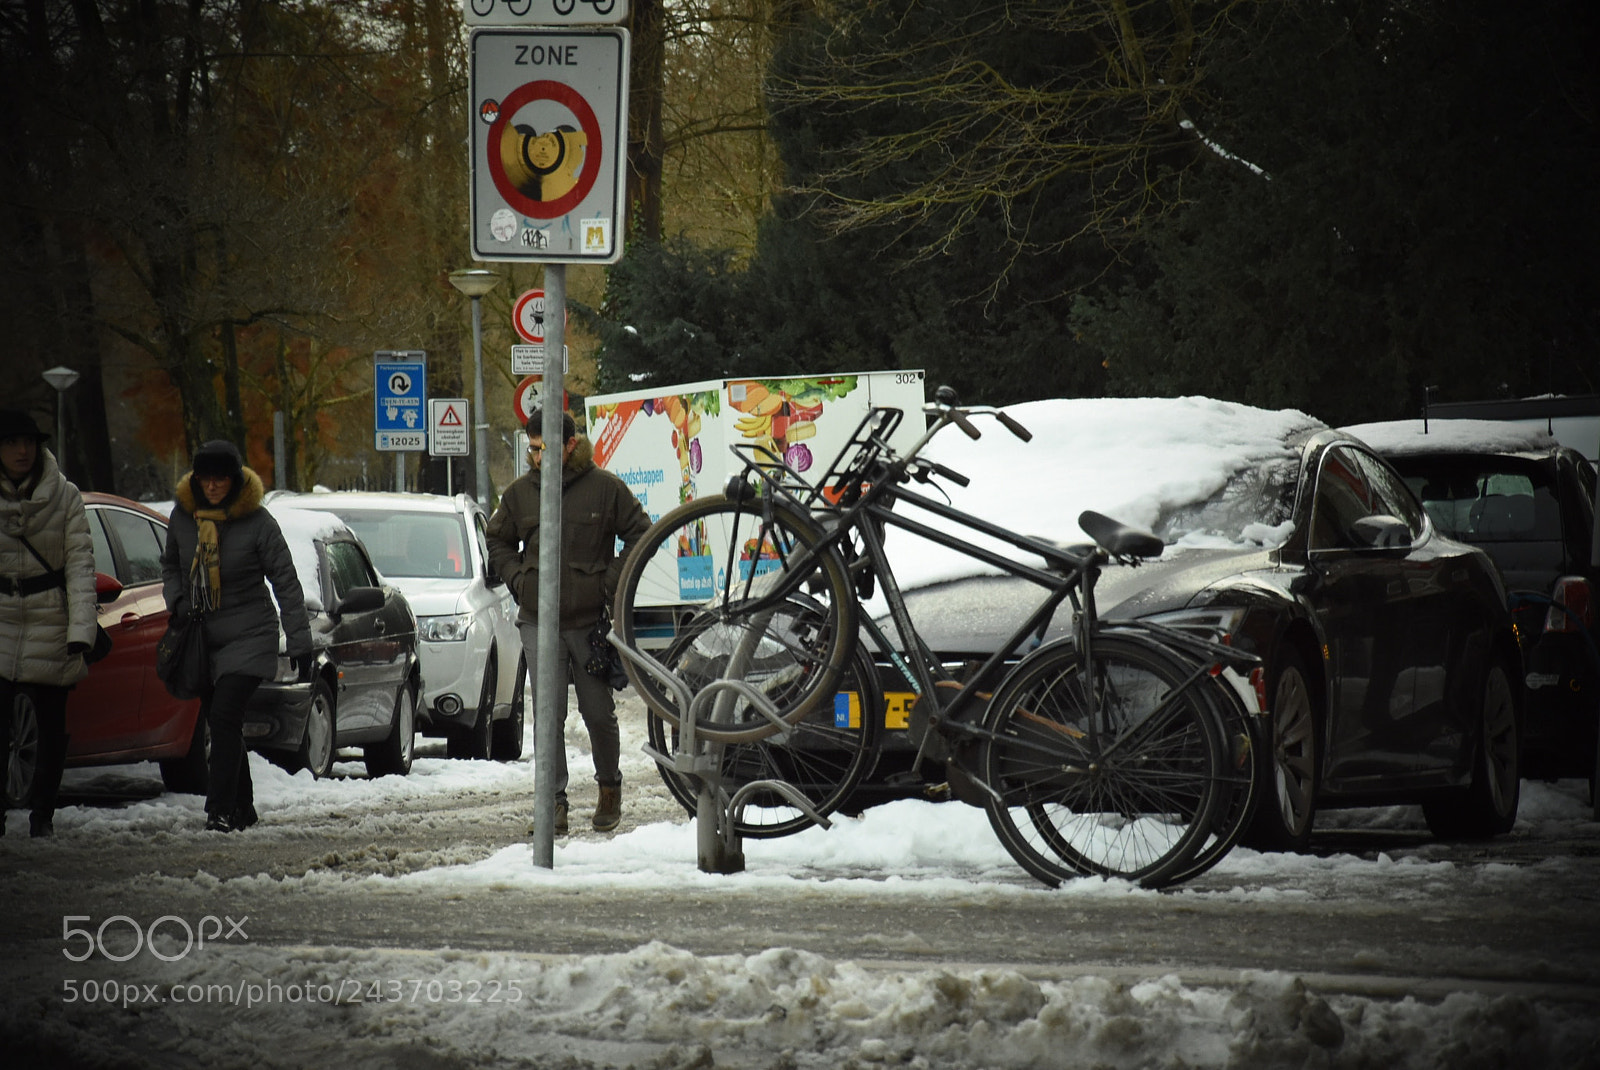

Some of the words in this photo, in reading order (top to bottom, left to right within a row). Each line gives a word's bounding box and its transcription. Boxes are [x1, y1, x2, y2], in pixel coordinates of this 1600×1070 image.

[514, 45, 578, 66] ZONE
[895, 372, 916, 385] 302
[391, 437, 420, 446] 12025
[836, 713, 847, 722] NL
